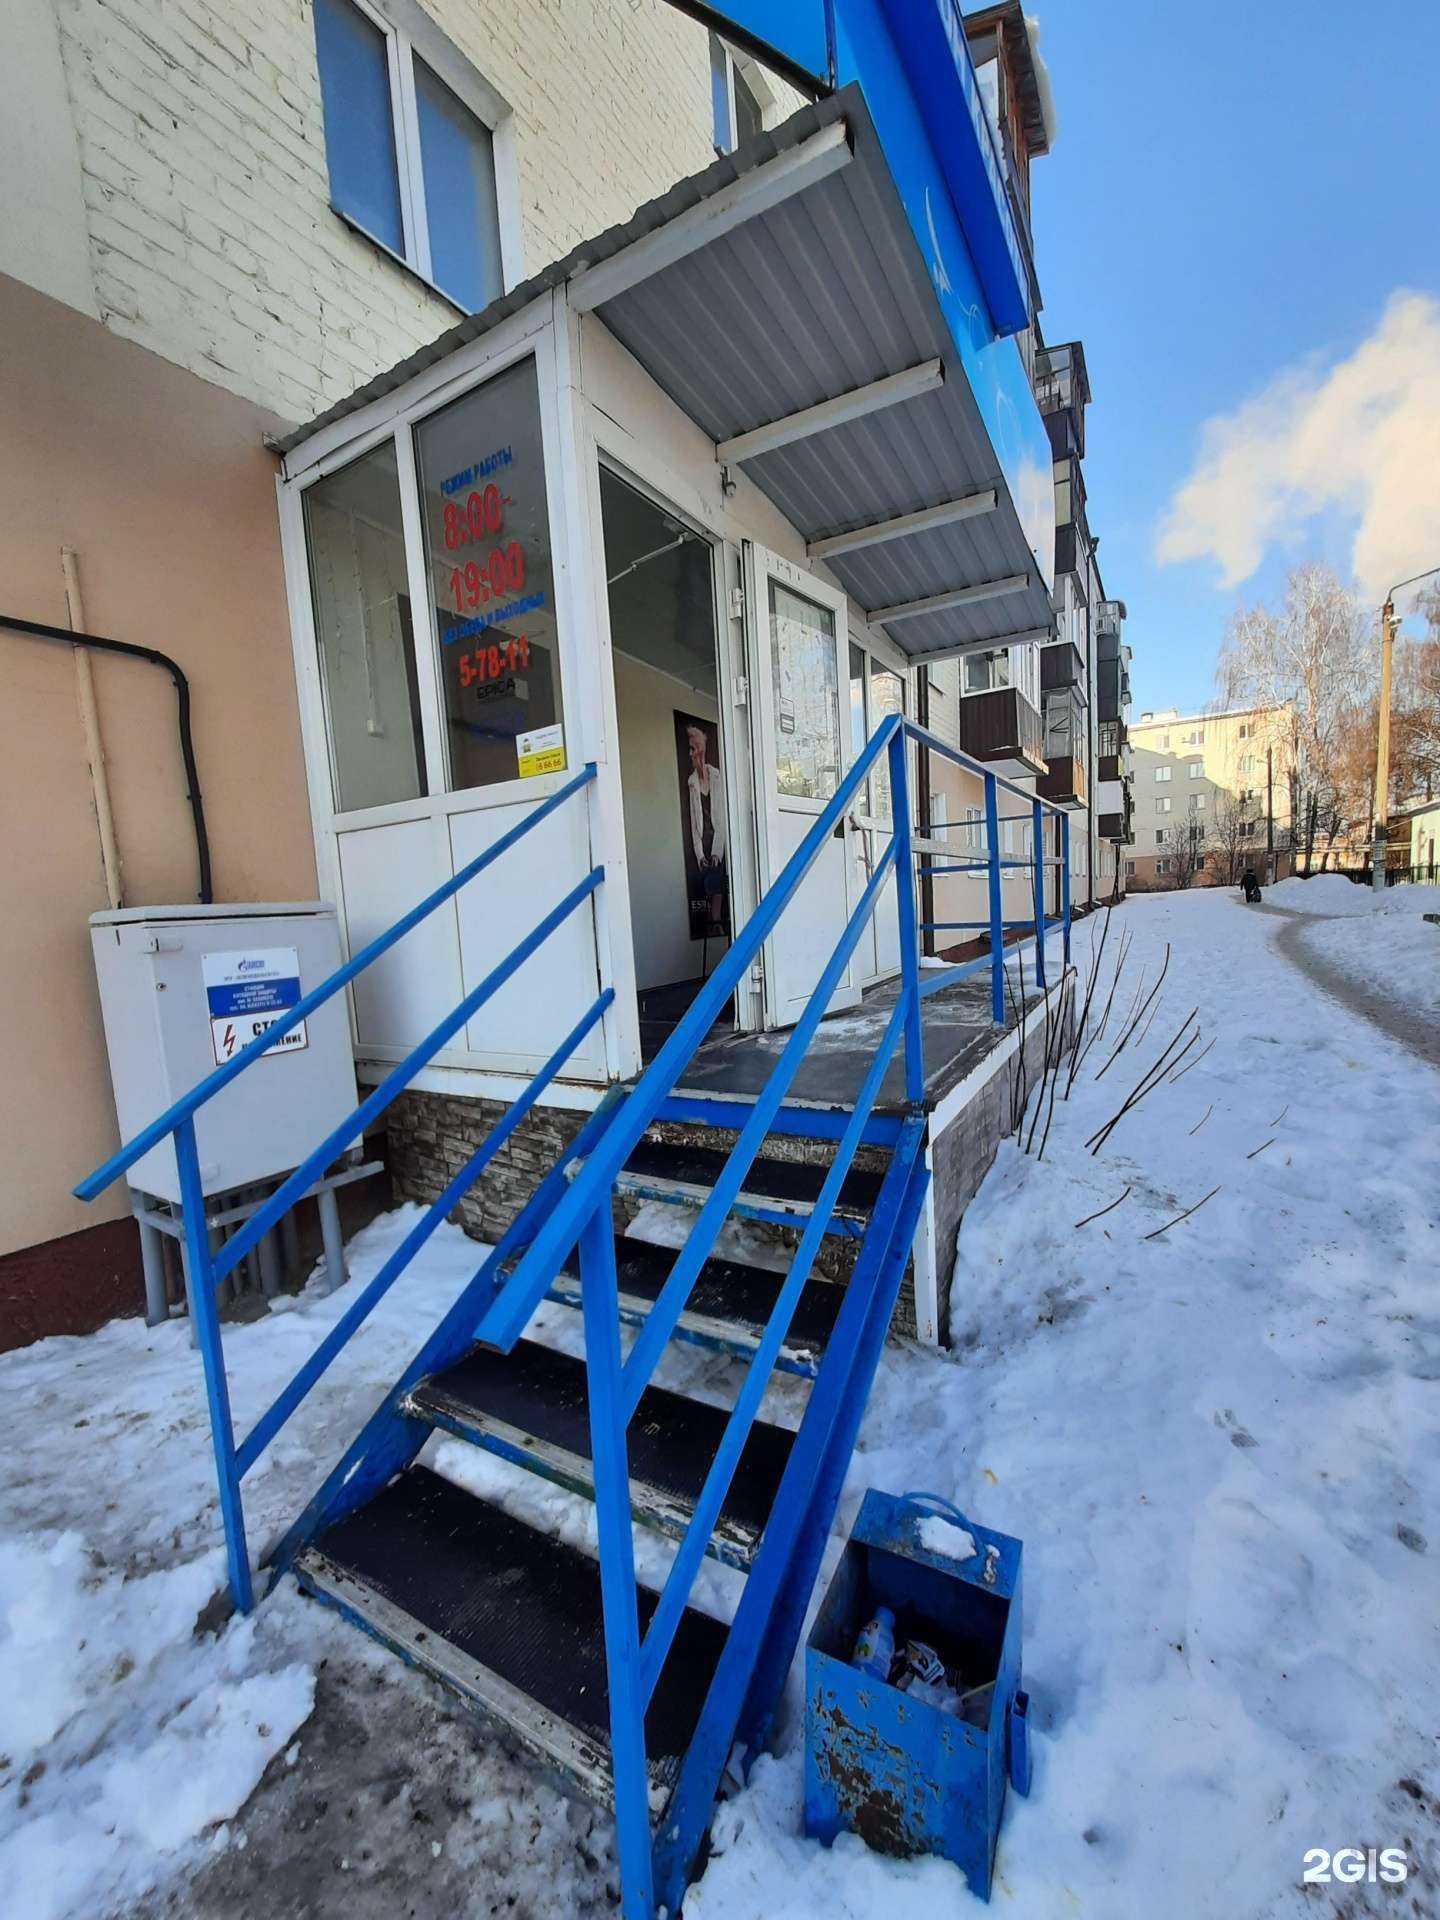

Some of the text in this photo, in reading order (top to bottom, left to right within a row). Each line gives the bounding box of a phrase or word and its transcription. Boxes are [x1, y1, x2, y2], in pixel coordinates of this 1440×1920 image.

[474, 445, 513, 480] РАБОТЫ
[451, 542, 525, 612] 19:00
[459, 632, 529, 687] 5-78-11
